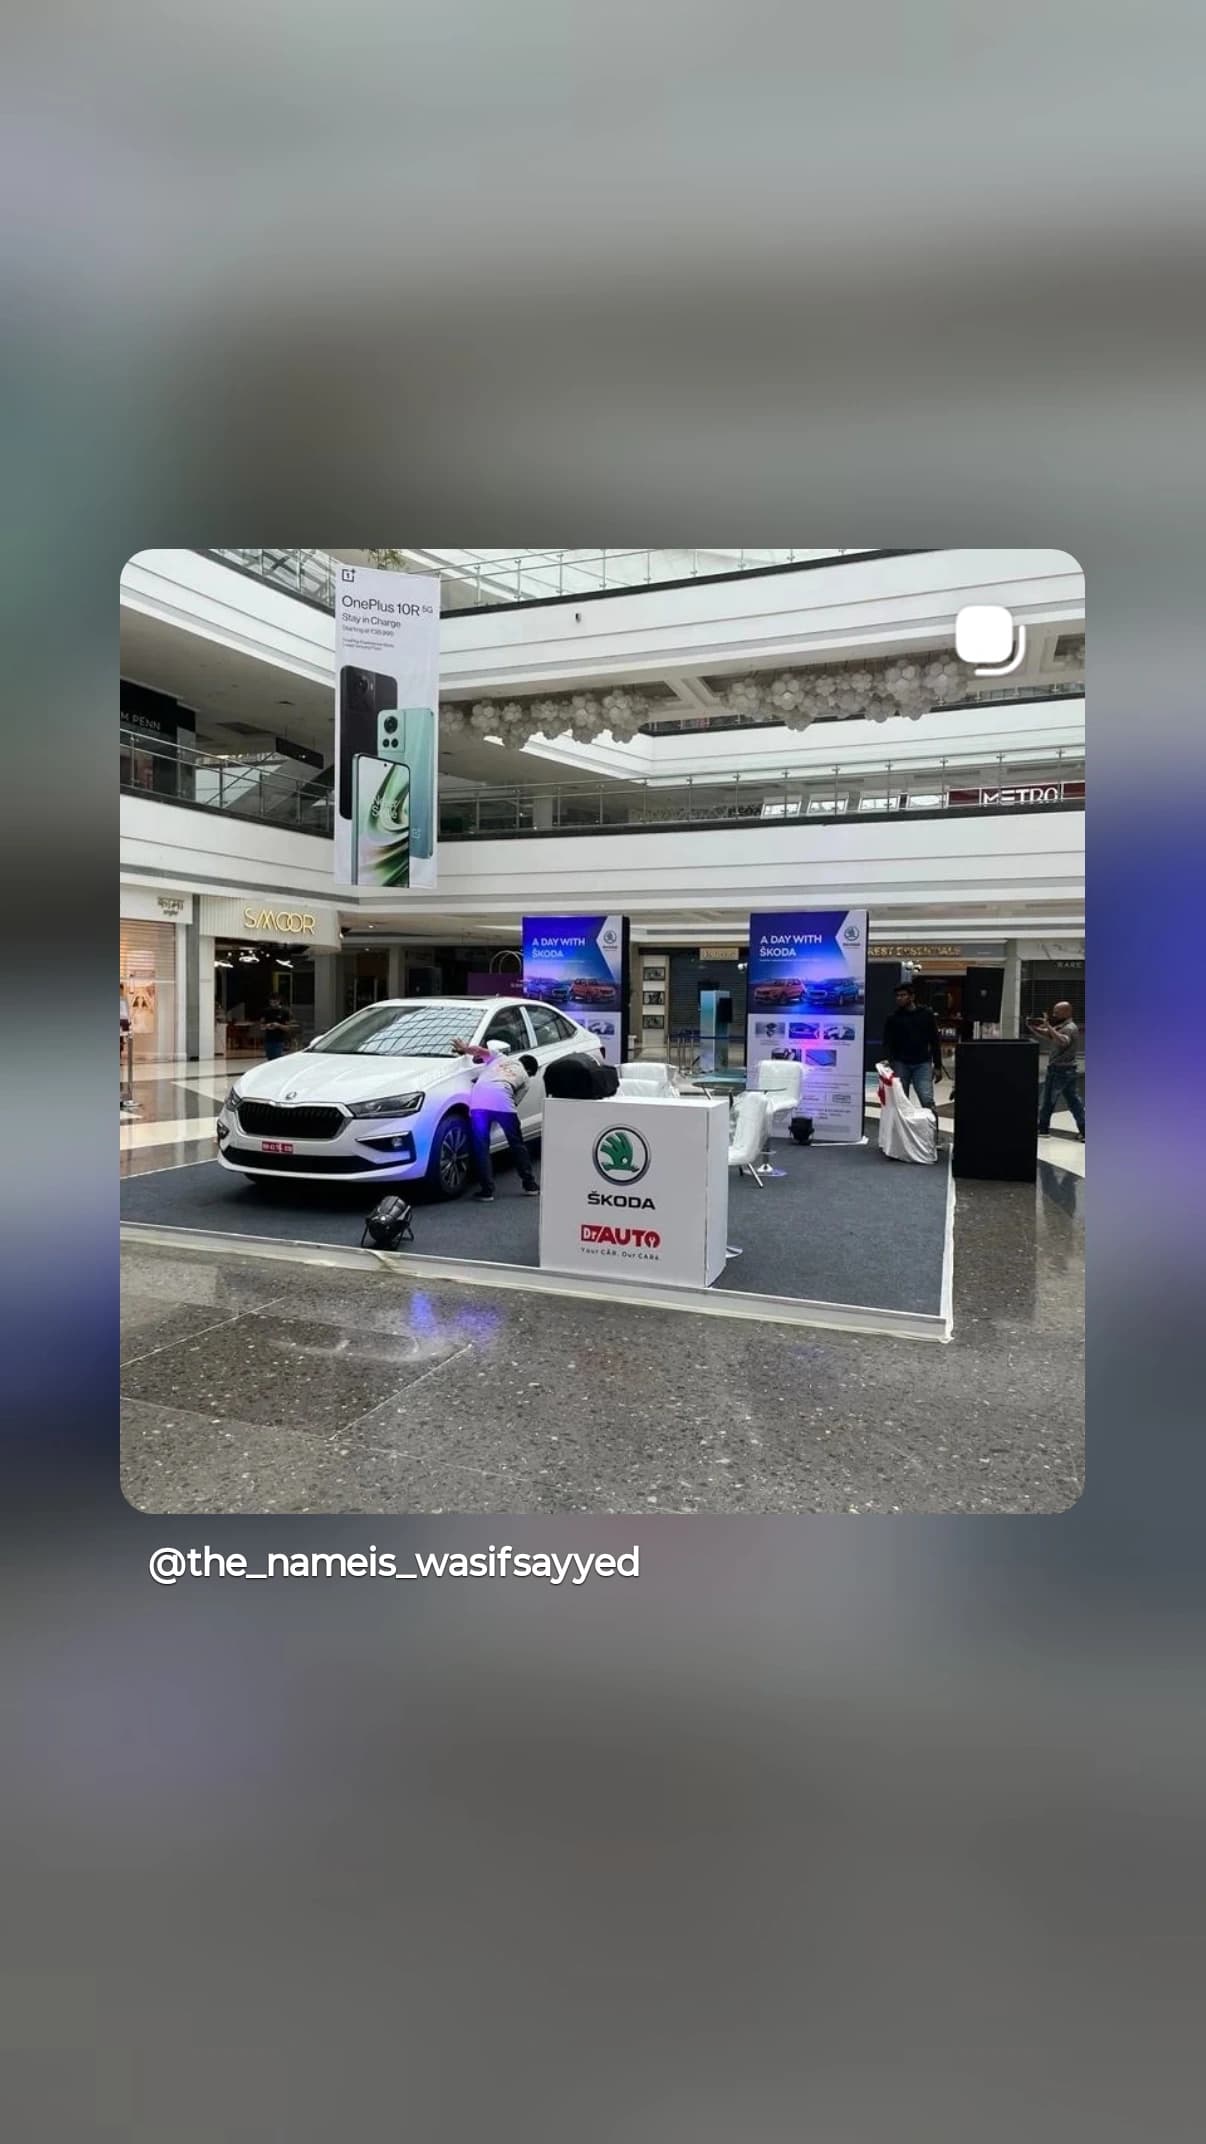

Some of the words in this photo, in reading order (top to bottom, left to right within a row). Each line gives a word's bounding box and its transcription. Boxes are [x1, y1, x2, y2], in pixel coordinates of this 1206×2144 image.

[342, 595, 395, 613] OnePlus
[397, 603, 420, 616] 10R
[422, 604, 433, 614] 5G
[342, 612, 361, 624] Stay
[362, 615, 370, 624] in
[371, 616, 401, 629] Charge
[132, 714, 161, 731] PENN
[983, 787, 1058, 805] METRO
[244, 907, 316, 935] SMOOR
[532, 937, 540, 946] A
[541, 937, 559, 946] DAY
[560, 937, 585, 946] WITH
[760, 935, 768, 945] A
[770, 935, 791, 944] DAY
[793, 934, 822, 944] WITH
[532, 948, 564, 958] ŠKODA
[760, 946, 797, 957] ŠKODA
[587, 1191, 656, 1210] ŠKODA
[581, 1247, 599, 1255] Your
[621, 1251, 636, 1259] Our
